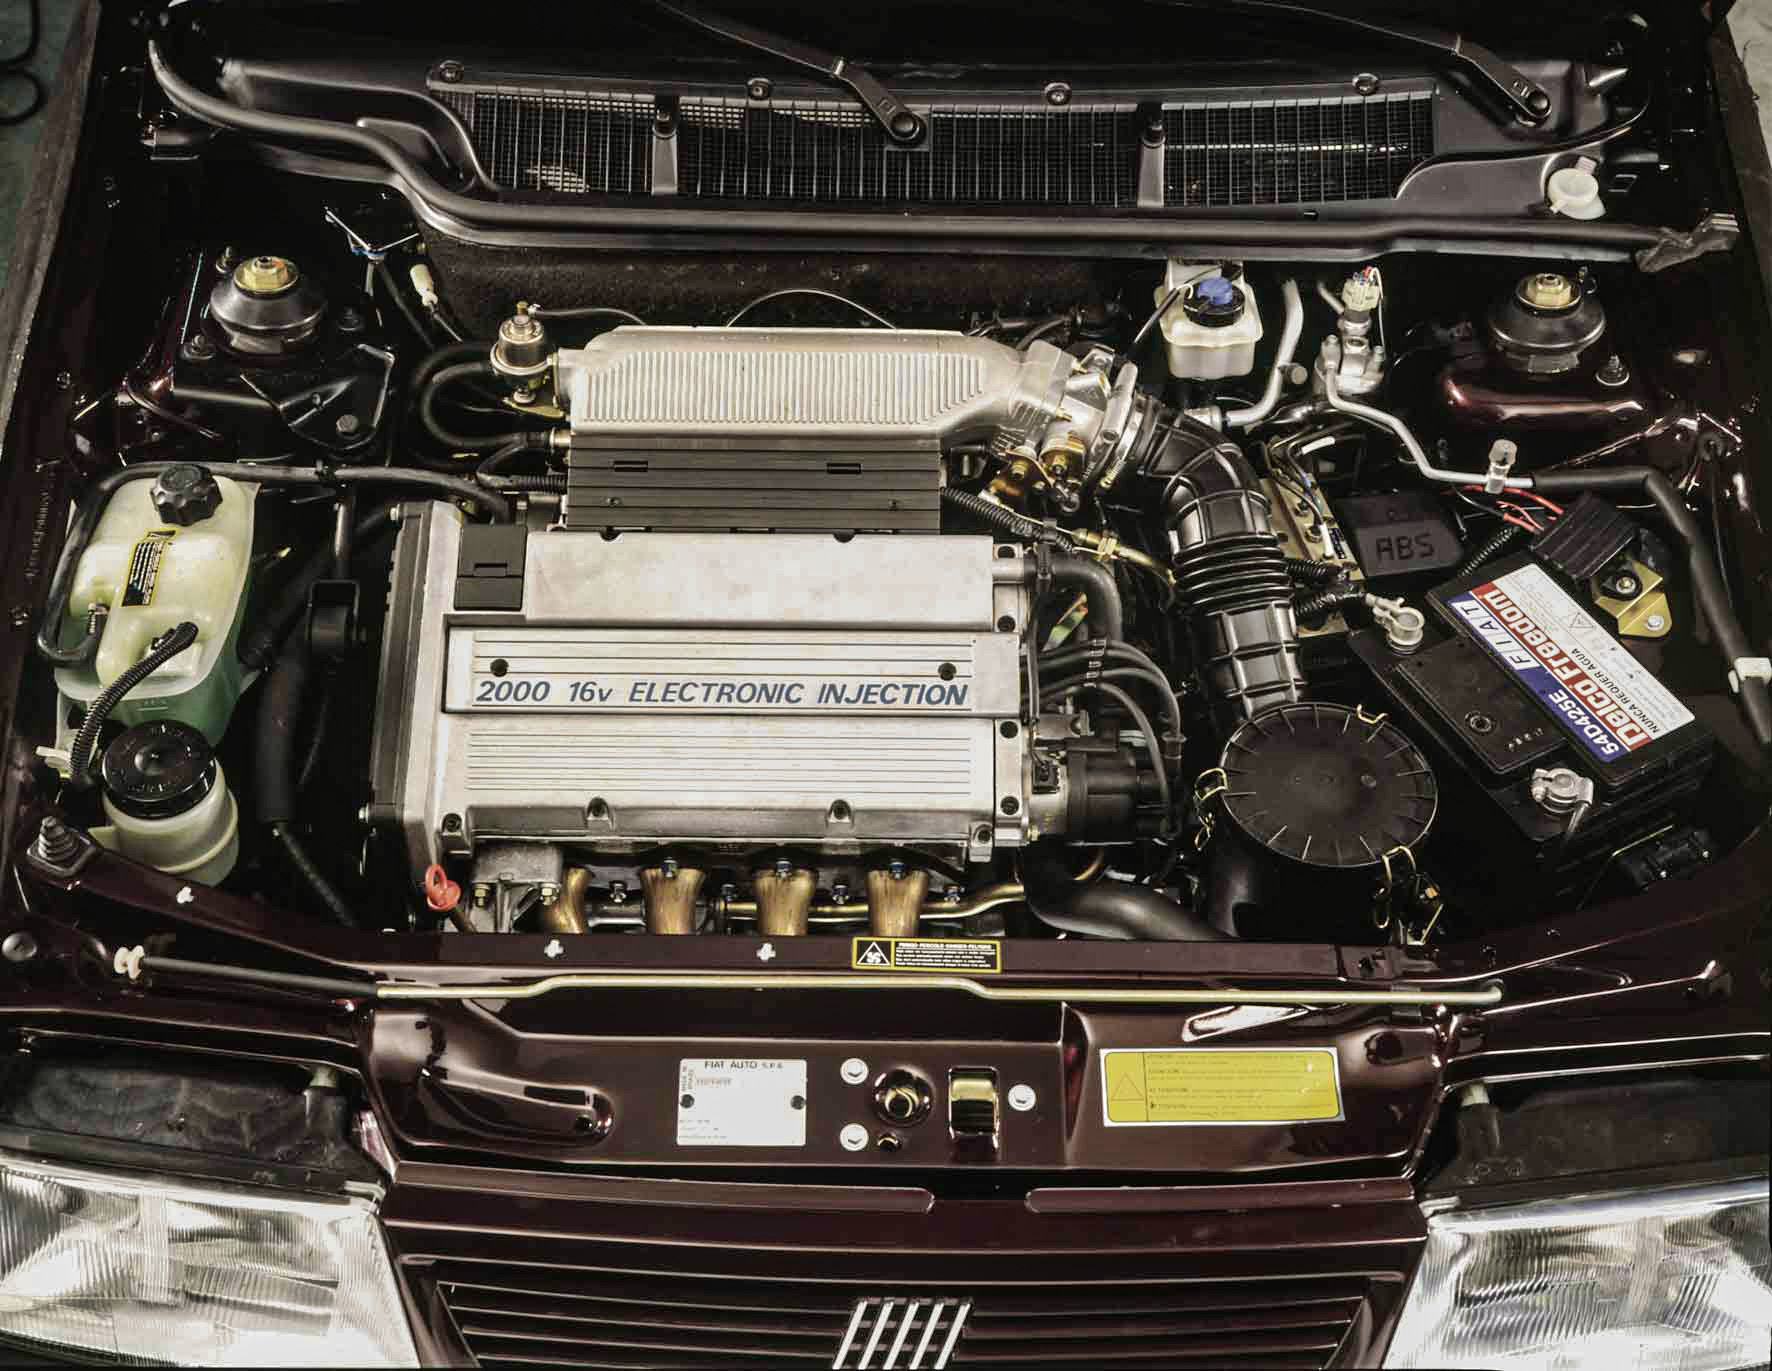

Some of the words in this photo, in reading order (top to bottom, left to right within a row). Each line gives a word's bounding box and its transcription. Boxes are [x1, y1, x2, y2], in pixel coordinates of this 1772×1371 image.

[1376, 532, 1434, 560] ABS
[1461, 605, 1532, 664] FIAT
[1483, 589, 1583, 681] Freedom
[1571, 648, 1596, 671] AGUA
[476, 681, 550, 702] 2000
[568, 681, 613, 703] 16v
[629, 682, 805, 704] ELECTRONIC
[817, 683, 969, 706] INJECTION
[1594, 671, 1631, 704] REQUER
[1549, 689, 1619, 755] 54D425E
[1573, 679, 1648, 748] Delco
[1628, 704, 1659, 733] NUNCA
[704, 1060, 725, 1069] FIAT
[730, 1060, 758, 1069] AUTO
